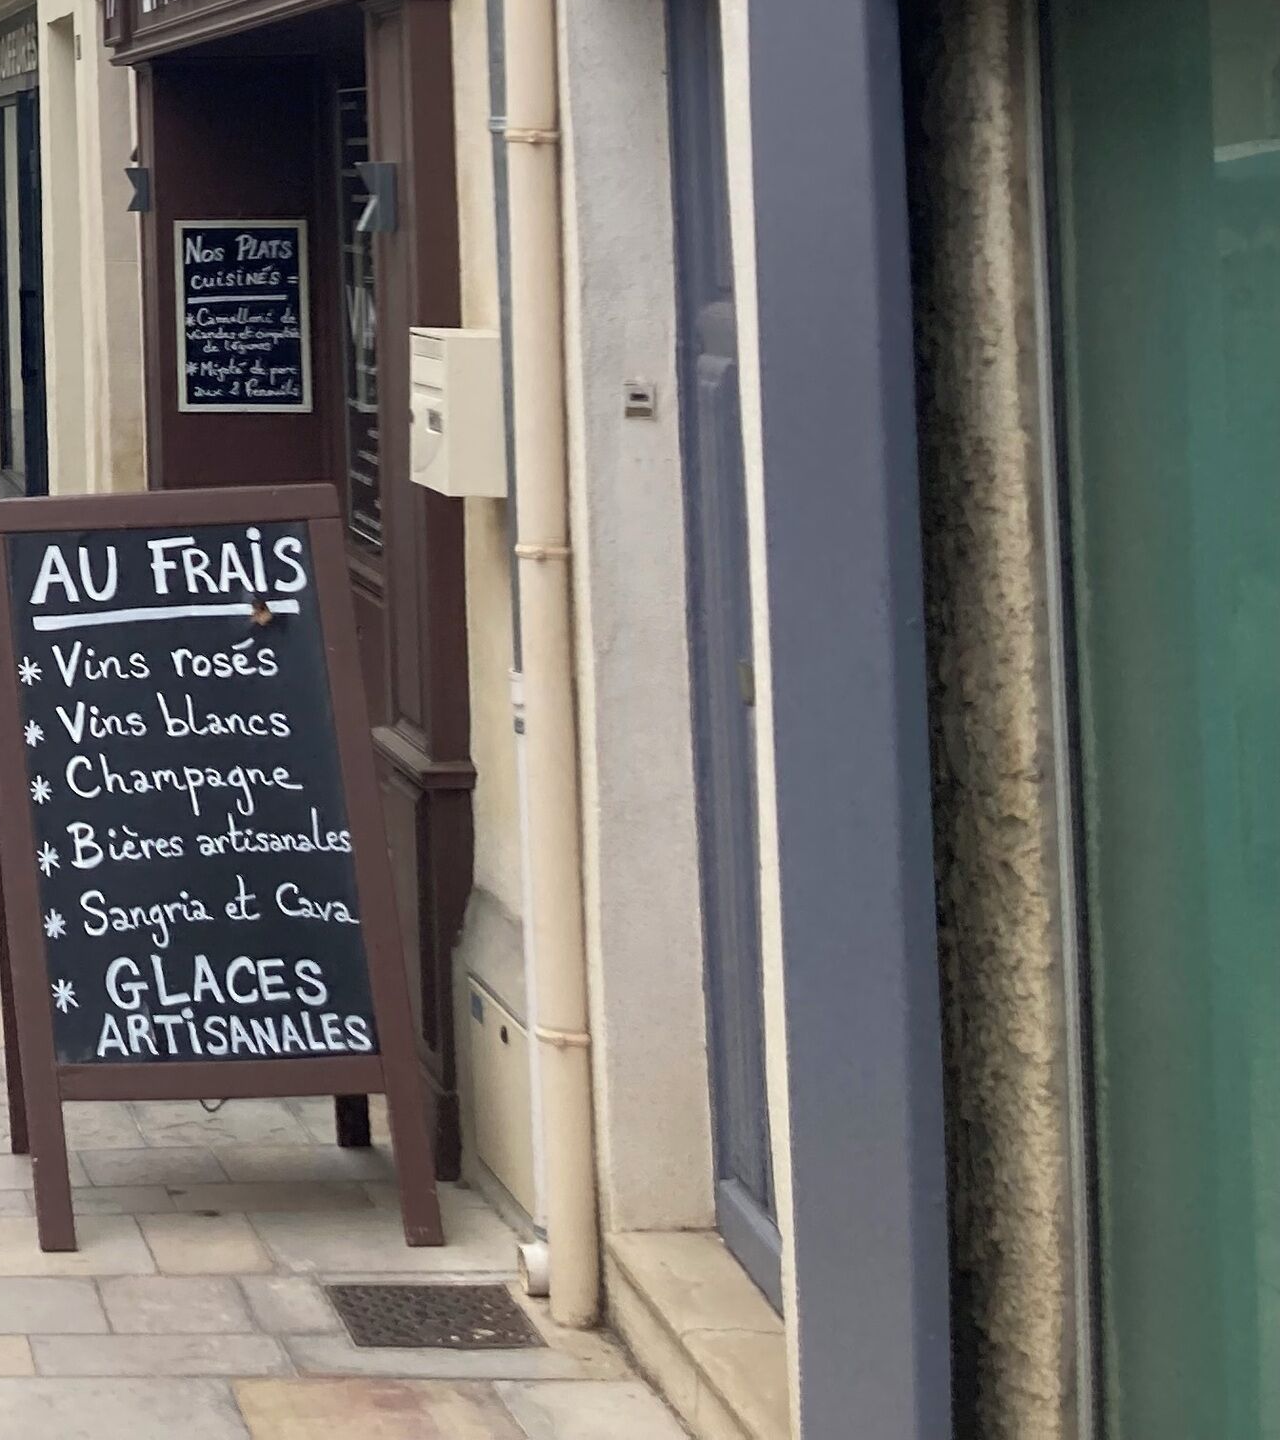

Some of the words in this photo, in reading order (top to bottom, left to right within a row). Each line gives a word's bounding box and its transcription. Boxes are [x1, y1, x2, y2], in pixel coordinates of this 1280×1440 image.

[235, 234, 293, 261] PLATS
[29, 544, 118, 604] AU
[51, 640, 149, 688] Vins
[170, 638, 279, 679] rosés
[56, 701, 147, 744] Vins
[156, 692, 291, 738] blancs
[66, 754, 303, 816] Champagne
[66, 822, 184, 869] Bières
[196, 807, 352, 857] artisanales
[80, 891, 214, 949] Sangria
[224, 875, 260, 921] et
[275, 882, 361, 925] Cava
[105, 954, 328, 1009] GLACES
